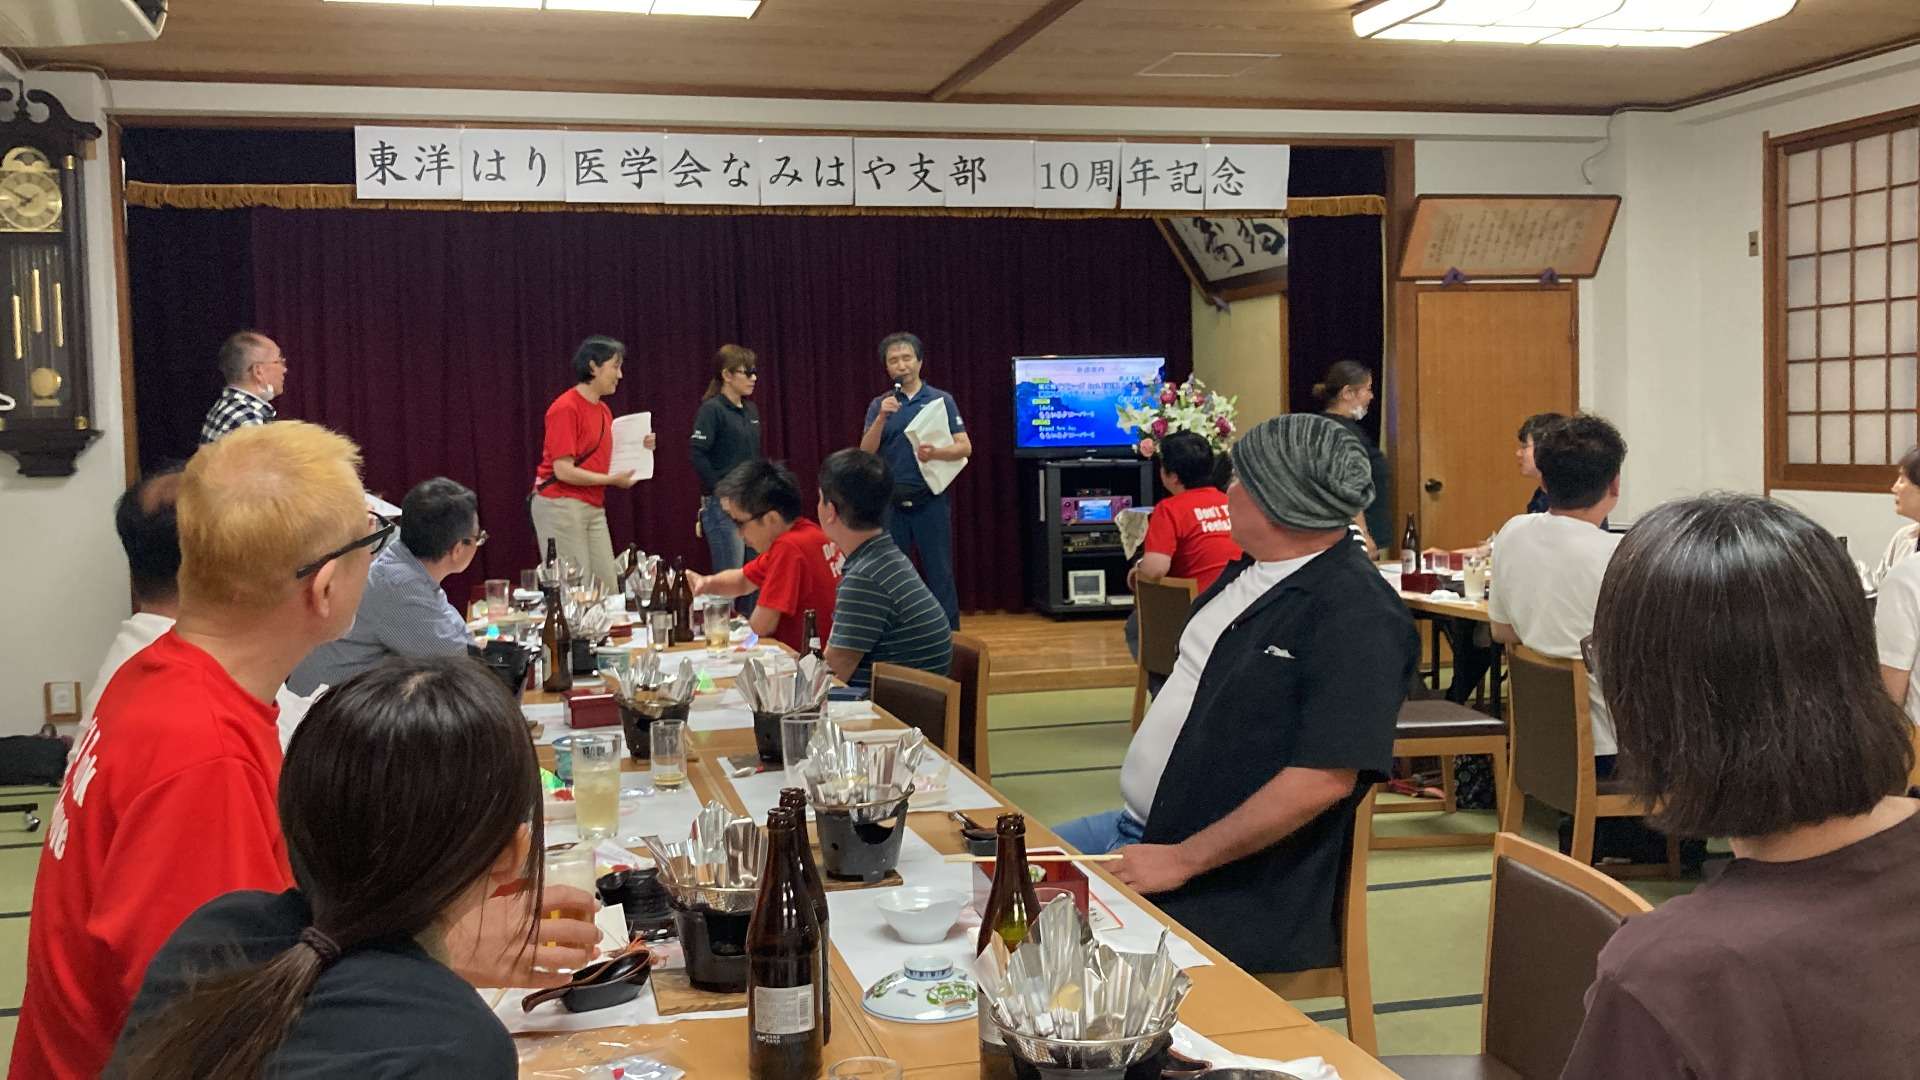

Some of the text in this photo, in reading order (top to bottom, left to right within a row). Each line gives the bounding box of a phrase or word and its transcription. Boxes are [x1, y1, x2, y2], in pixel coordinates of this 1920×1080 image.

[363, 140, 1246, 198] 東洋はり医学会なみはや支部 10周年記念
